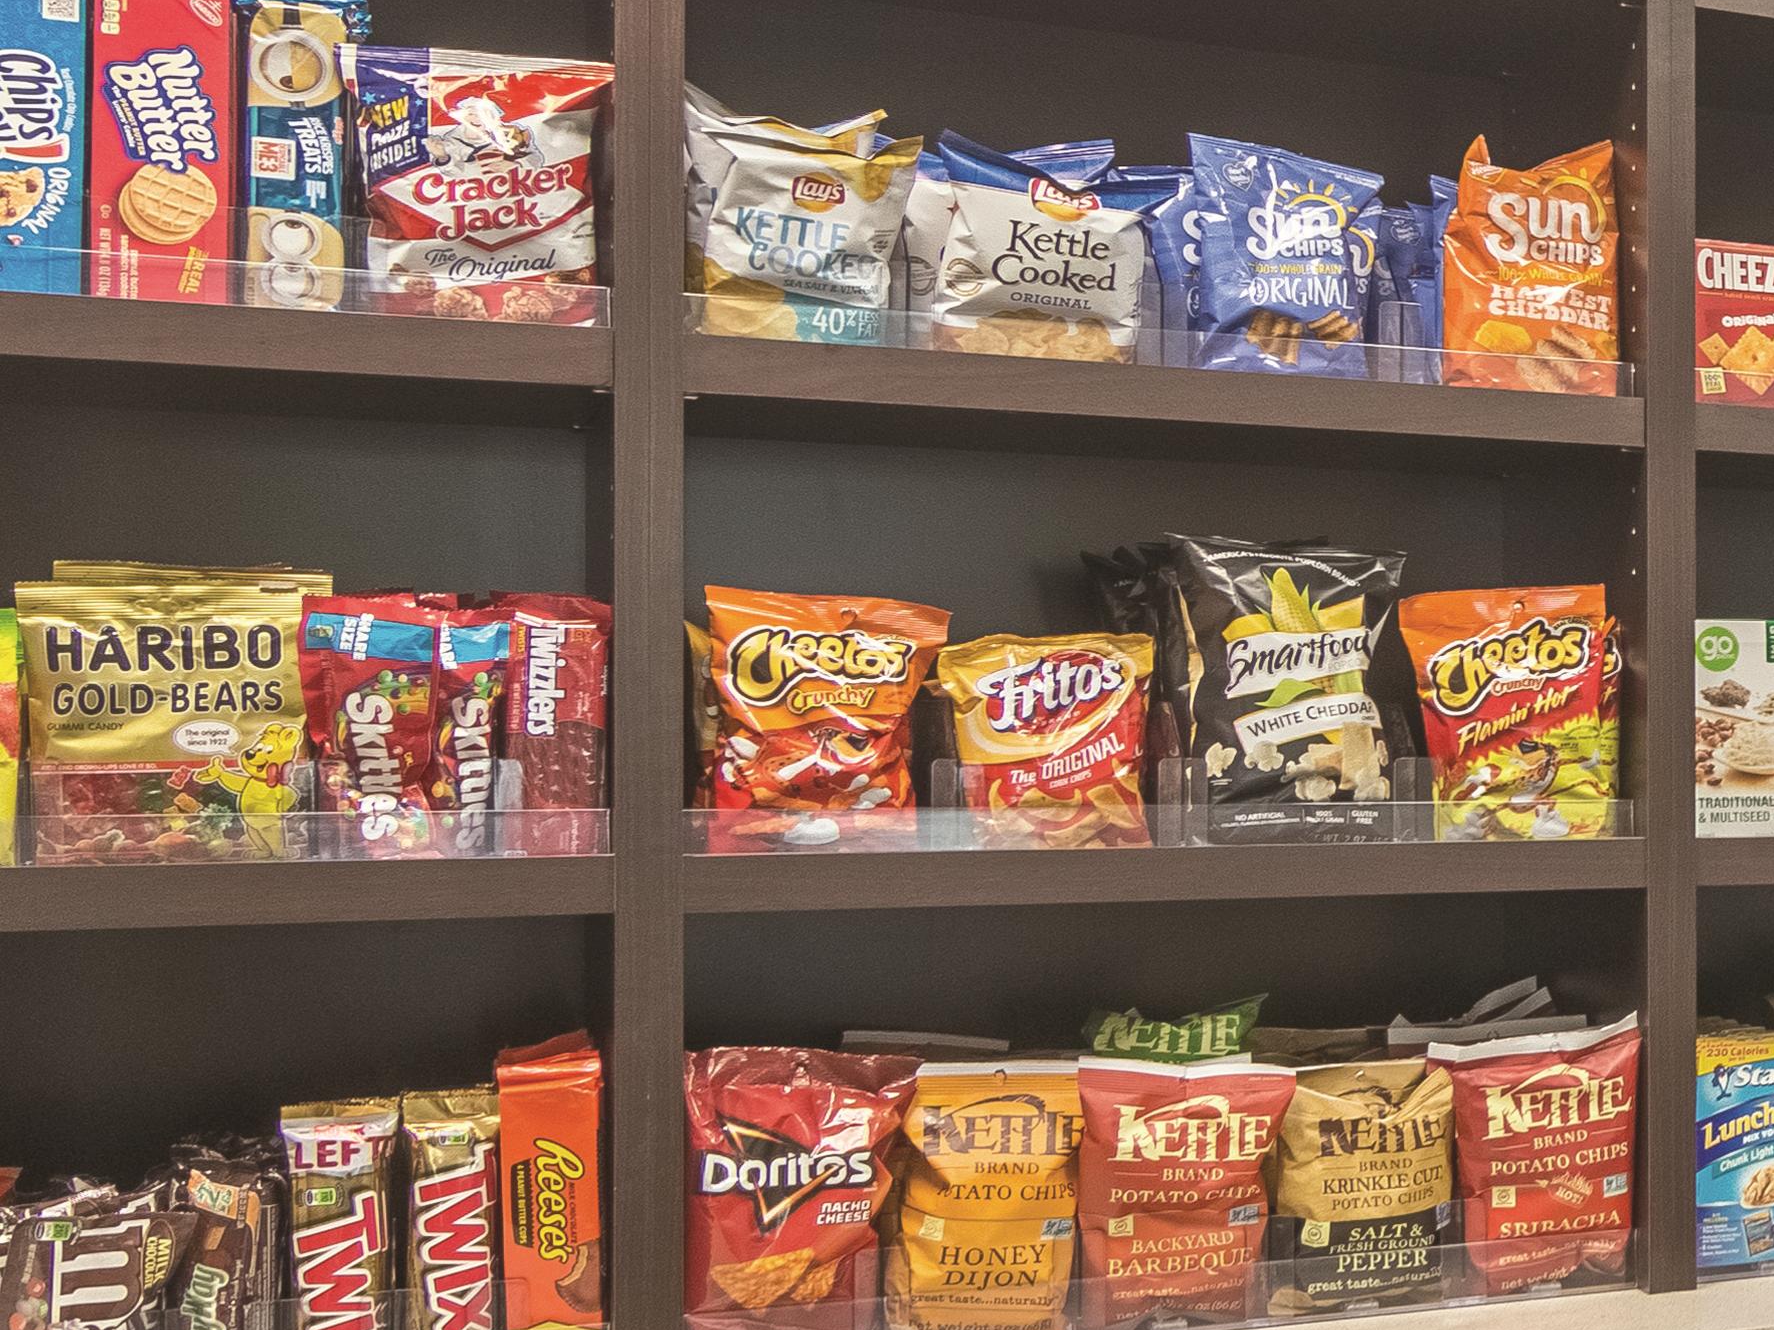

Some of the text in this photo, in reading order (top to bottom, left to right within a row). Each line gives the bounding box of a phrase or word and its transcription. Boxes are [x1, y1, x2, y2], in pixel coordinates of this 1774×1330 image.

[108, 63, 186, 170] Butter
[149, 47, 218, 161] Nutter
[412, 164, 573, 205] Cracker
[793, 178, 846, 204] Lay's
[438, 201, 541, 241] Jack
[737, 207, 851, 250] KETTLE
[1487, 191, 1601, 263] Sun
[1009, 220, 1110, 261] Kettle
[1530, 240, 1605, 266] CHIPS
[424, 248, 556, 282] The Original
[748, 243, 881, 279] COOKED
[992, 252, 1117, 292] Cooked
[1010, 291, 1092, 310] ORIGINAL
[1487, 298, 1611, 332] CHEDDAR
[45, 624, 282, 673] HARIBO
[1701, 635, 1733, 663] go
[527, 626, 566, 736] Twizzlers
[728, 626, 915, 706] Cheetos
[1428, 621, 1594, 715] Cheetos
[53, 680, 283, 716] GOLD-BEARS
[787, 685, 874, 715] Crunchy
[978, 659, 1124, 732] Fritos
[346, 692, 403, 840] Skittles
[1010, 733, 1125, 784] The ORIGINAL
[1699, 812, 1707, 822] &
[1710, 810, 1771, 822] MULTISEED
[1483, 1063, 1633, 1141] KETTLE
[1108, 1094, 1274, 1163] KETTLE
[1533, 1129, 1588, 1149] BRAND
[702, 1152, 872, 1193] Doritos
[974, 1162, 1039, 1175] BRAND
[1162, 1168, 1224, 1181] BRAND
[1359, 1158, 1413, 1171] BRAND
[1490, 1141, 1628, 1176] POTATO CHIPS
[821, 1200, 871, 1213] NACHO
[1332, 1187, 1434, 1210] POTATO CHIPS
[817, 1211, 870, 1224] CHEESE
[1500, 1210, 1622, 1238] SRIRACHA
[939, 1243, 1046, 1267] HONEY
[1131, 1230, 1234, 1254] BACKYARD
[1329, 1234, 1435, 1254] FRESH GROUND
[1107, 1248, 1254, 1277] BARBEQUE
[1336, 1248, 1428, 1272] PEPPER
[944, 1269, 1038, 1291] DIJON
